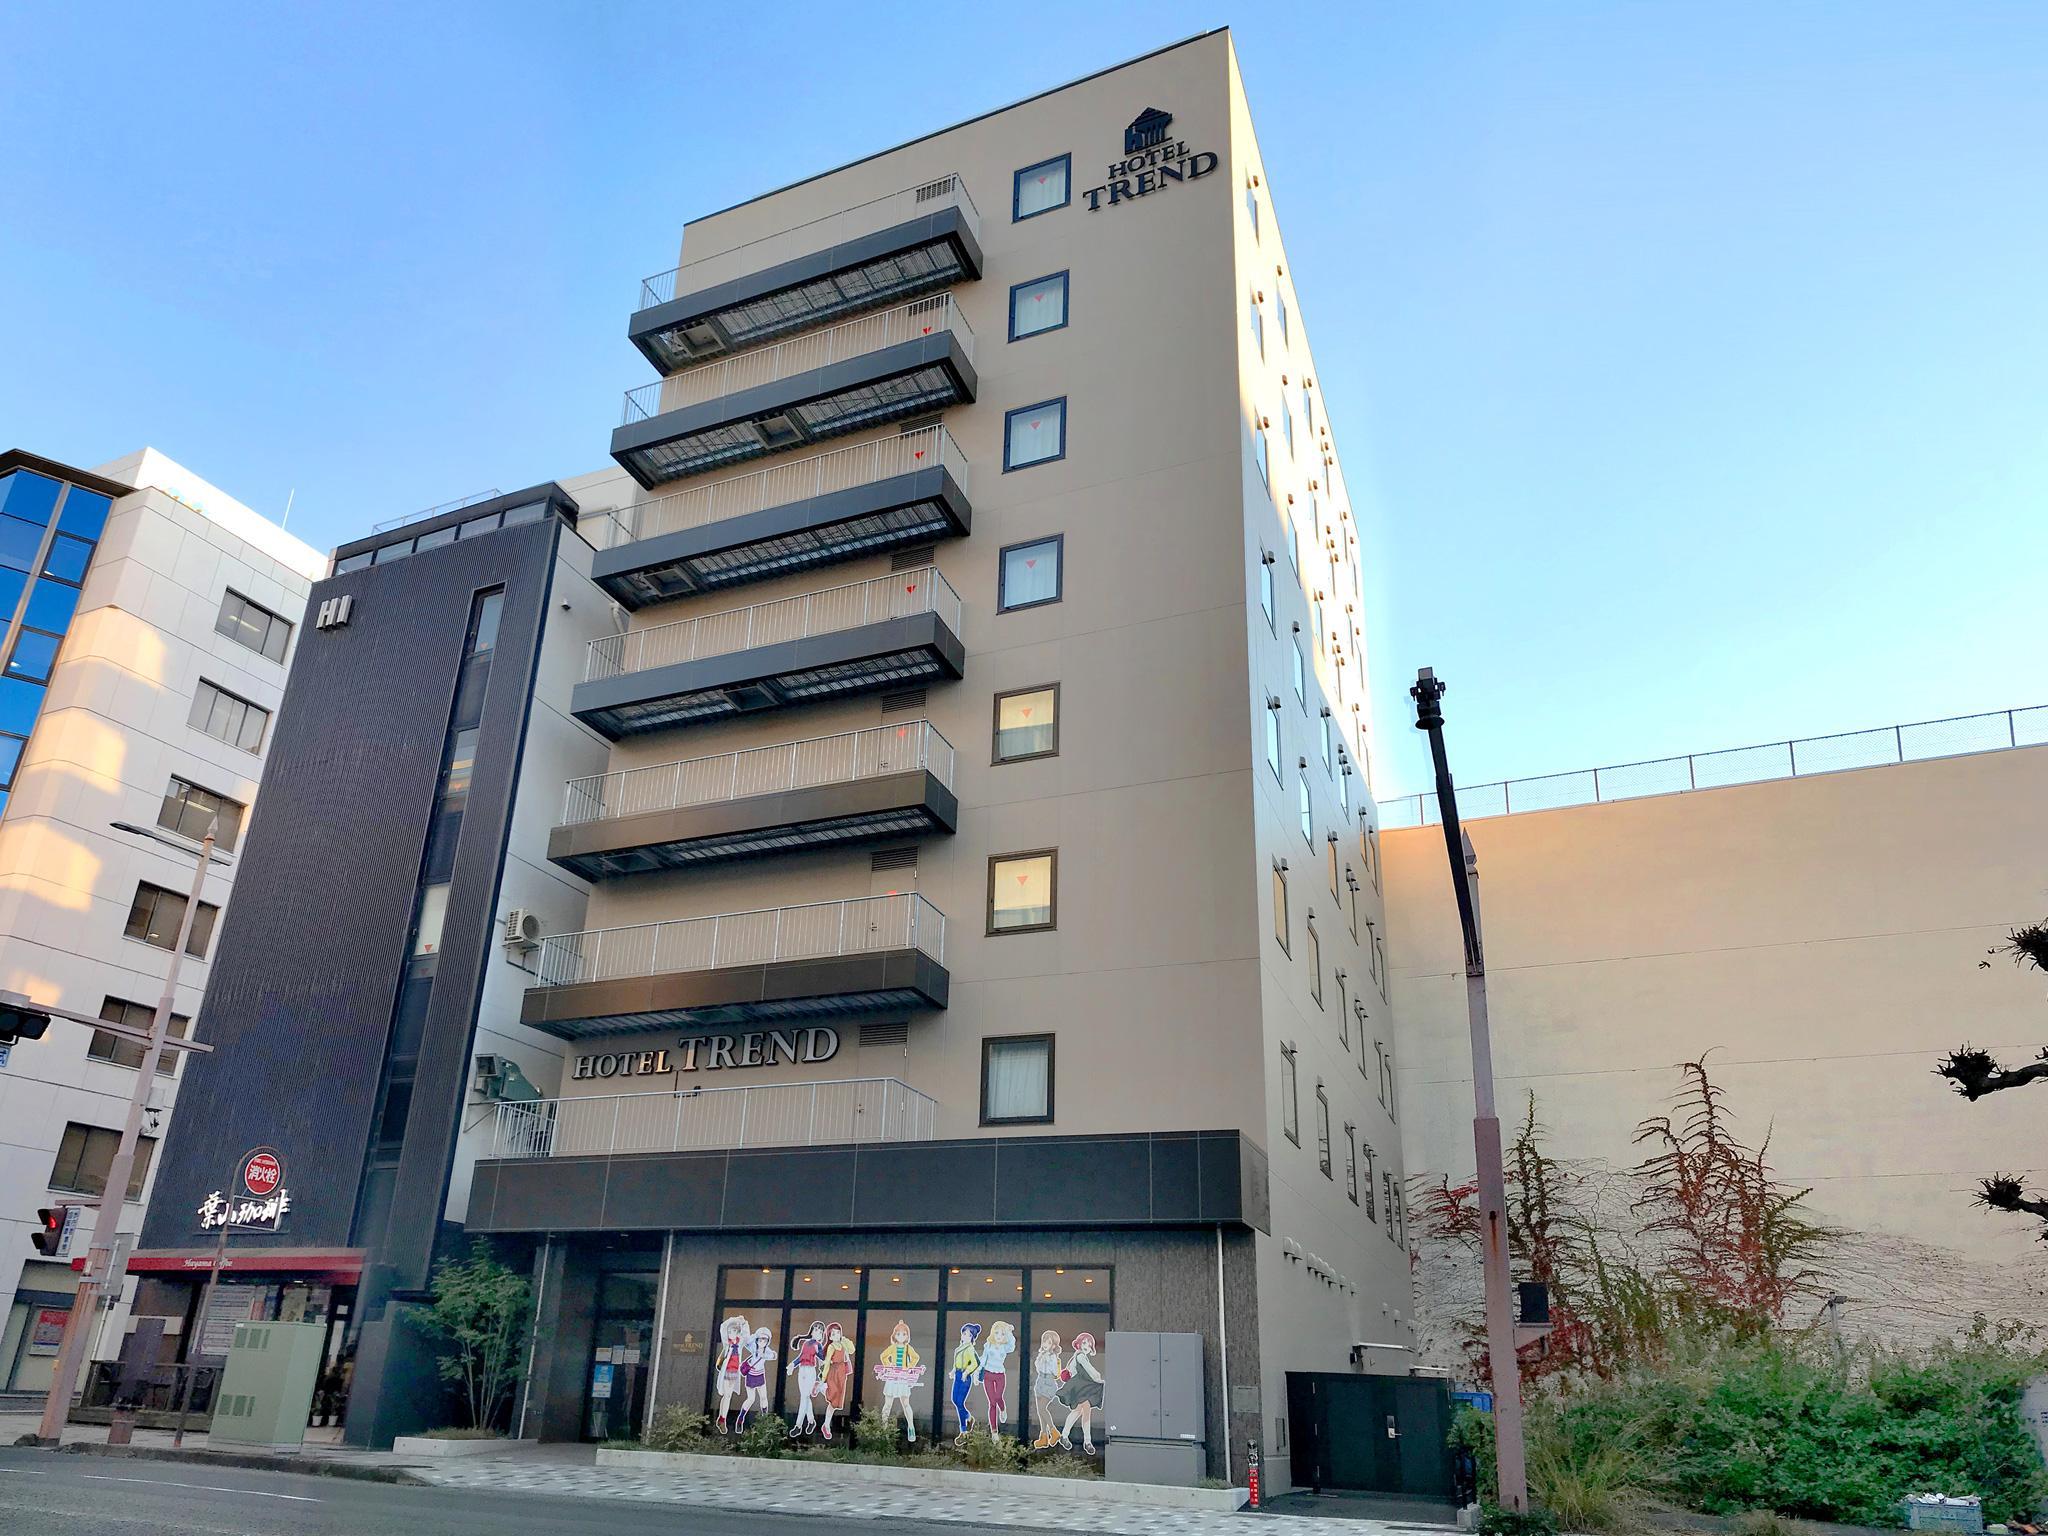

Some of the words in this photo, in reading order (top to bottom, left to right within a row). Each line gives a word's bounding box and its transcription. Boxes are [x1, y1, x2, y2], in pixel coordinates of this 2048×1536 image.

[1108, 141, 1190, 179] HOTEL
[1083, 152, 1218, 211] TREND
[316, 595, 352, 629] HI
[572, 1050, 673, 1080] HOTEL
[680, 1026, 840, 1072] TREND
[247, 1164, 278, 1184] 消火栓
